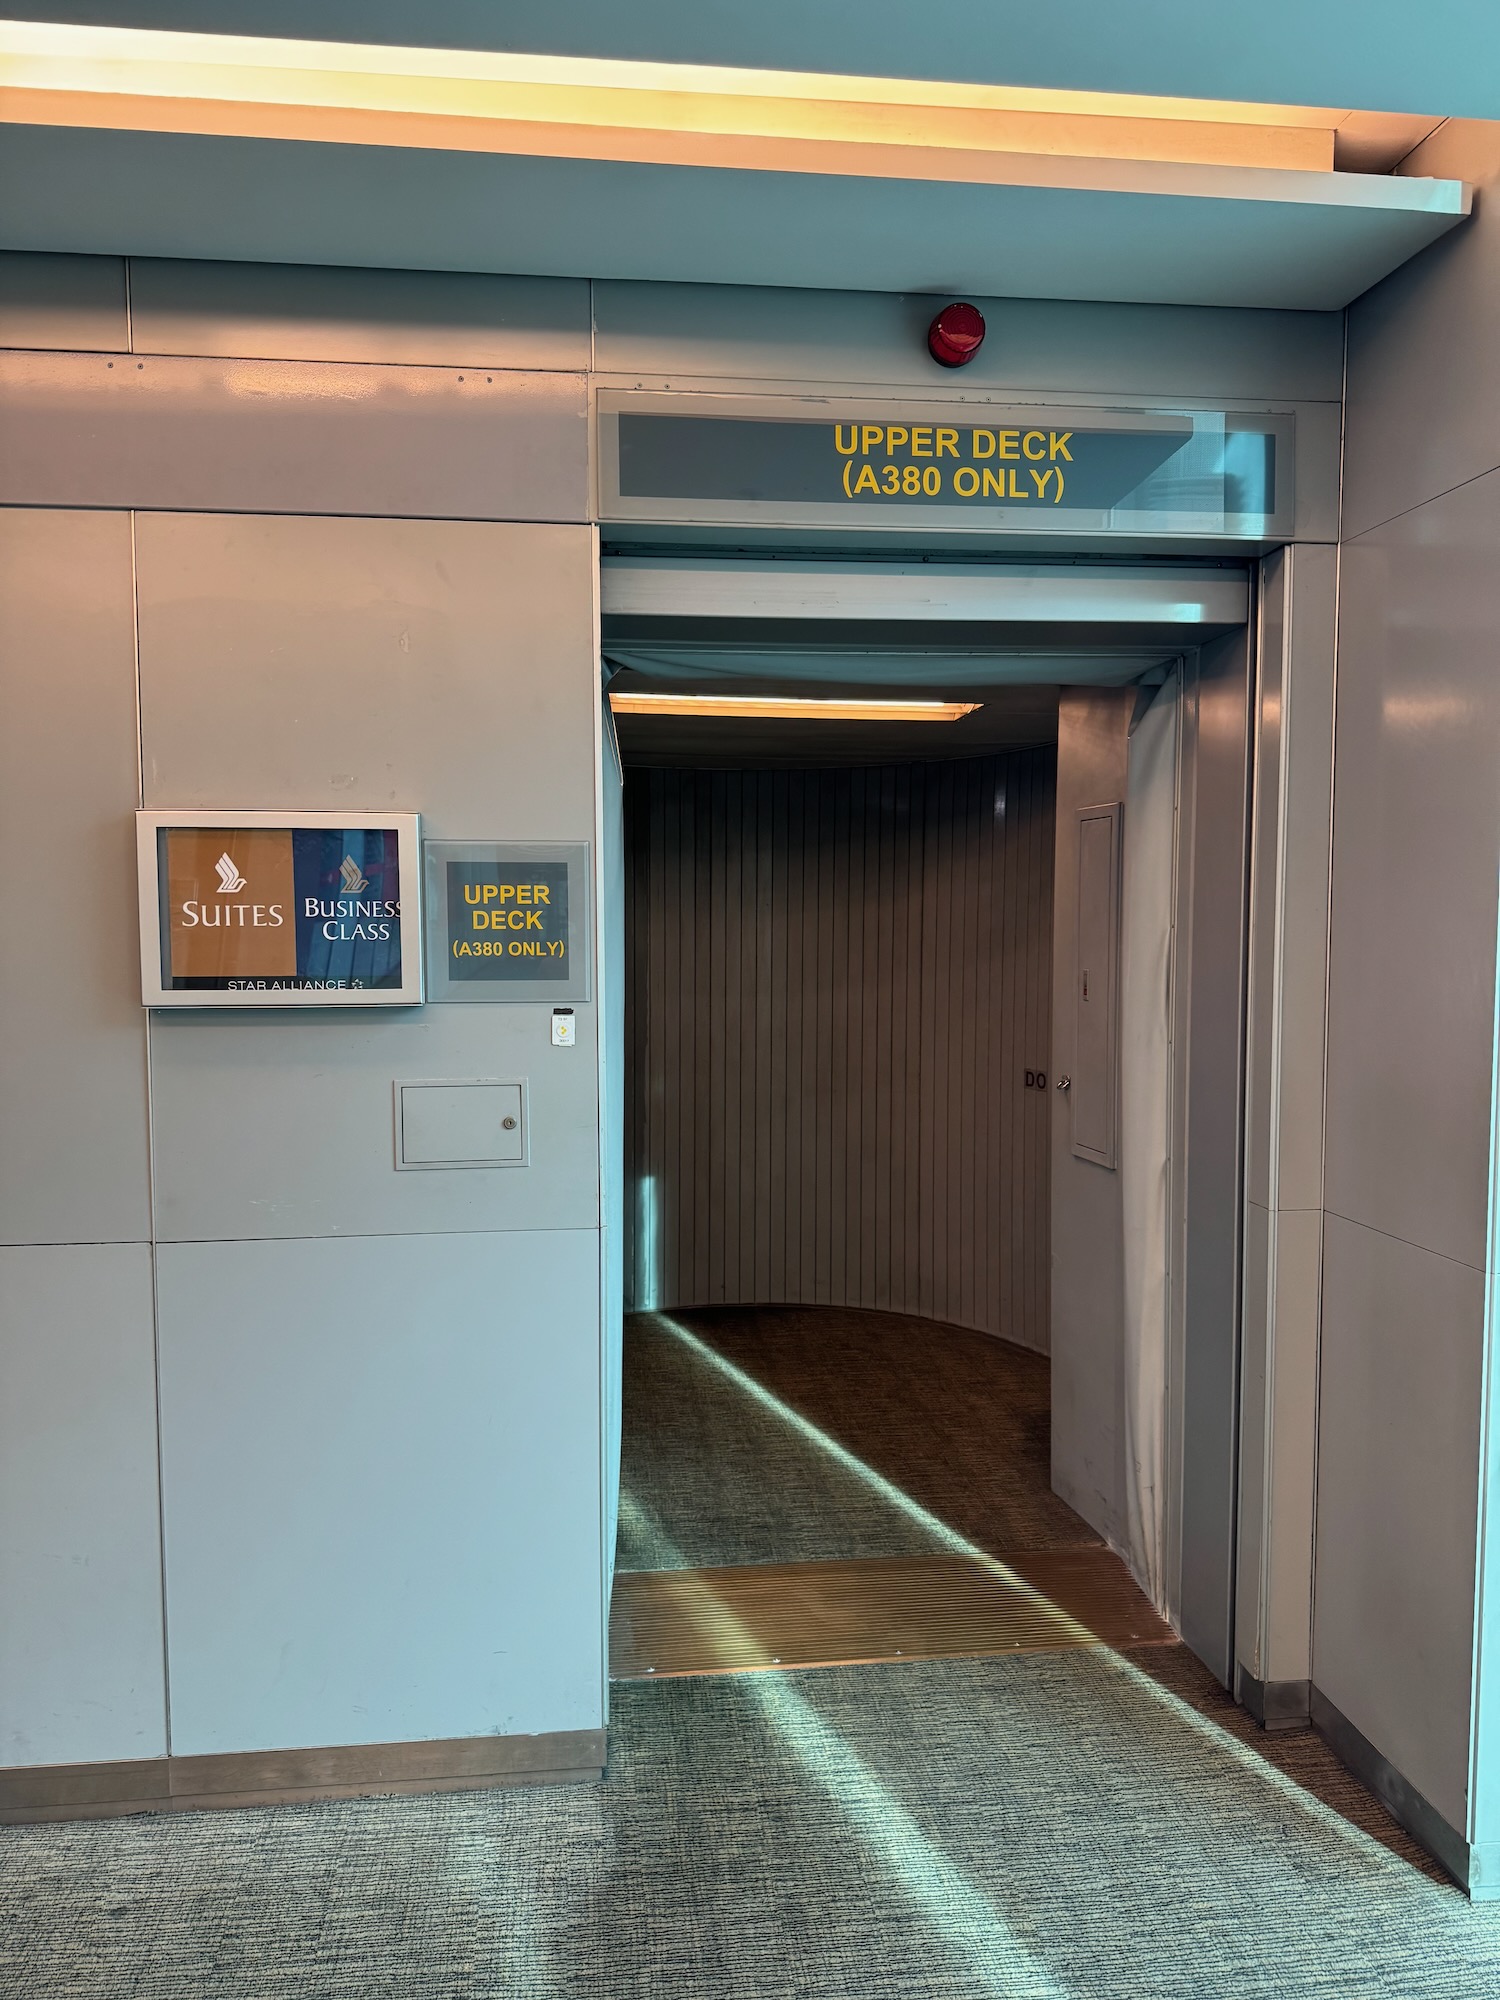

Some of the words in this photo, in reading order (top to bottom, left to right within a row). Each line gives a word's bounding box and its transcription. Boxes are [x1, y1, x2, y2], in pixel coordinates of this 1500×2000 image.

[834, 424, 960, 458] UPPER
[972, 429, 1074, 462] DECK
[842, 460, 942, 498] (A380
[953, 466, 1065, 504] ONLY)
[464, 884, 551, 905] UPPER
[182, 900, 284, 927] SUITES
[472, 910, 544, 930] DECK
[322, 920, 390, 941] CLASS
[453, 939, 503, 958] (A380
[508, 939, 565, 958] ONLY)
[227, 980, 267, 991] STAR
[271, 979, 347, 991] ALLIANCE
